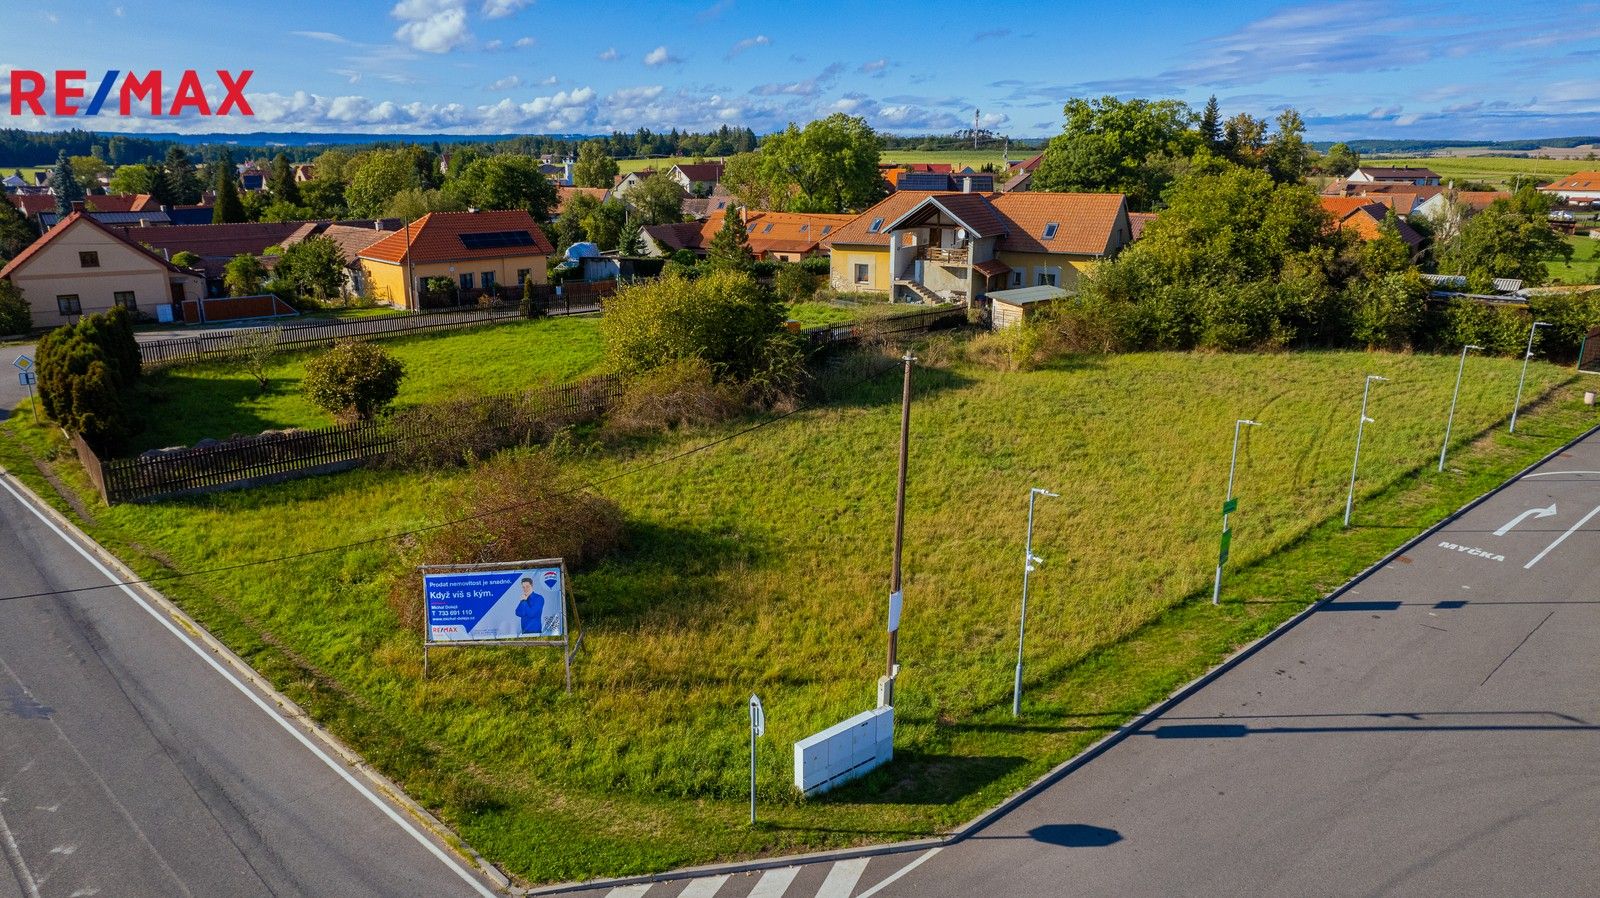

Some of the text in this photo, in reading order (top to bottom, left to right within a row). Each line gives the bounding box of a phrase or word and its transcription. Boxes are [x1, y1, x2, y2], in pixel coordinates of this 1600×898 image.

[1437, 541, 1505, 562] MYČKA
[430, 590, 451, 600] Když
[473, 589, 494, 598] kým.
